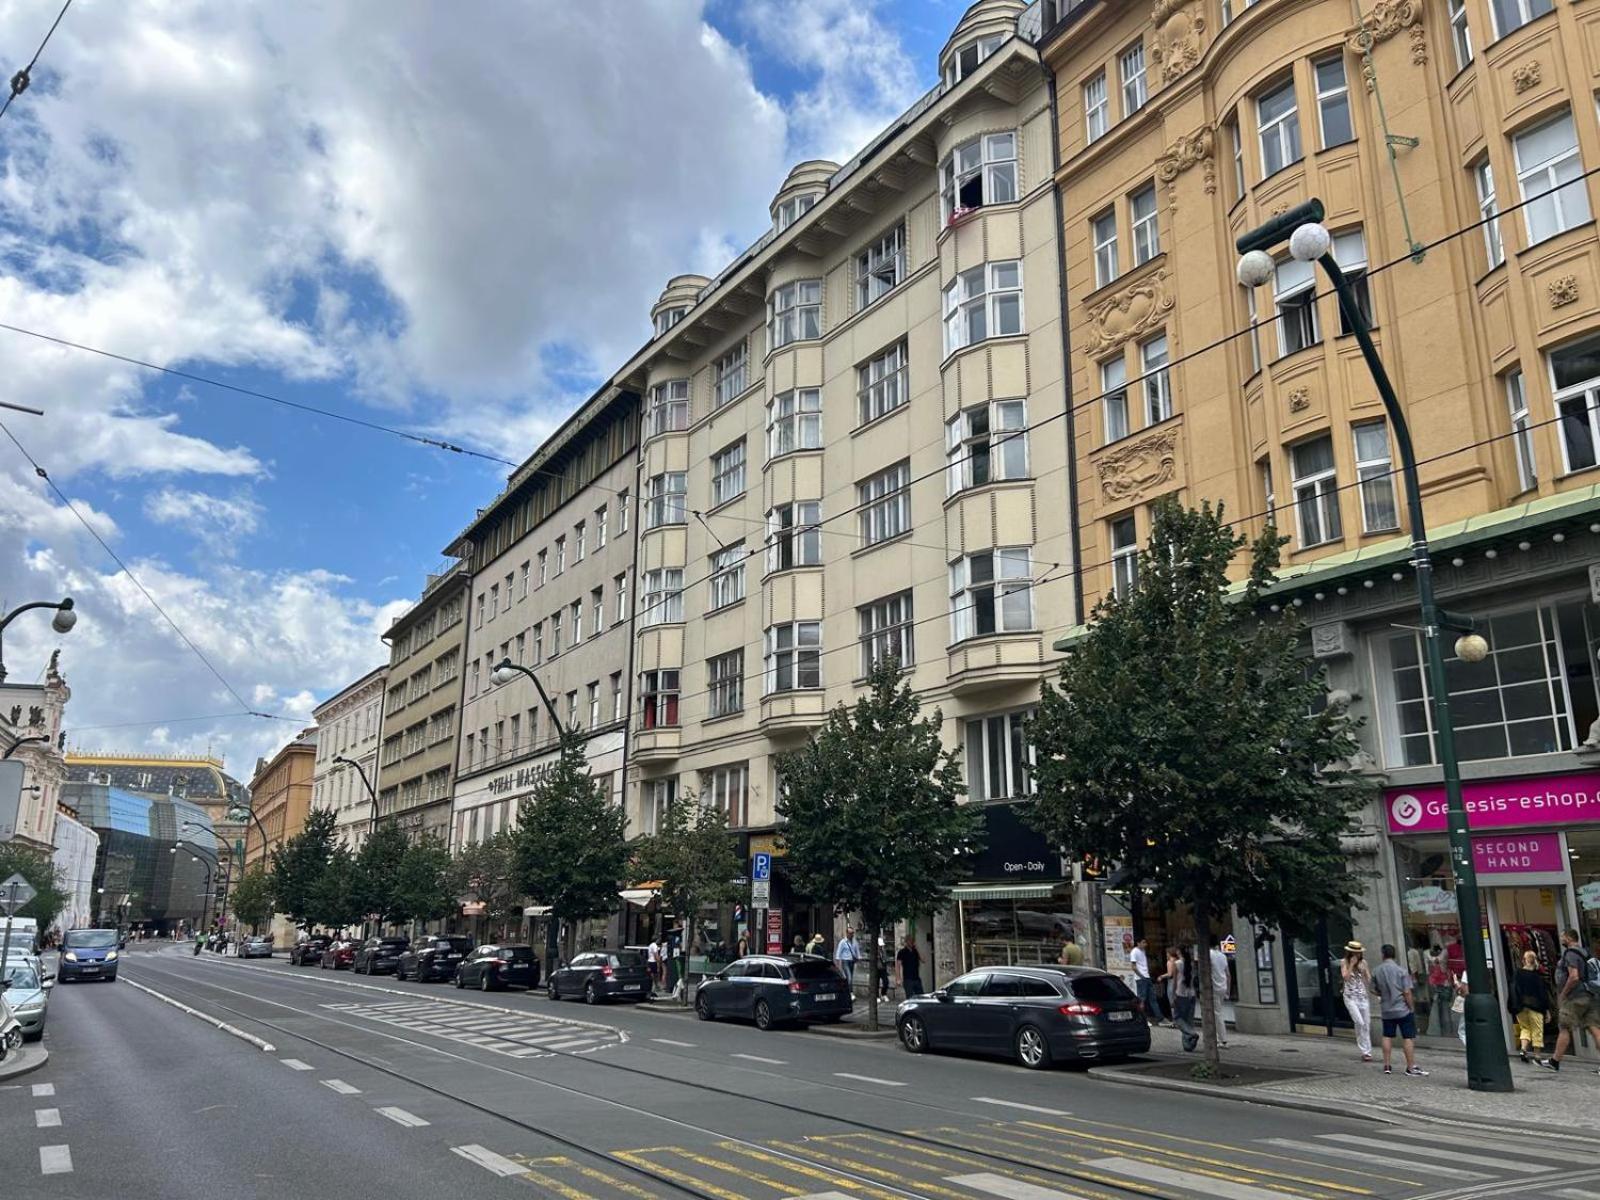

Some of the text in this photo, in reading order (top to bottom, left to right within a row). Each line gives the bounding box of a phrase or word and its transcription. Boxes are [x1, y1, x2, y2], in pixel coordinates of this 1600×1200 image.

[1475, 841, 1539, 855] SECOND
[757, 855, 767, 872] P
[1004, 861, 1045, 873] Open Daily
[1488, 856, 1531, 868] HAND
